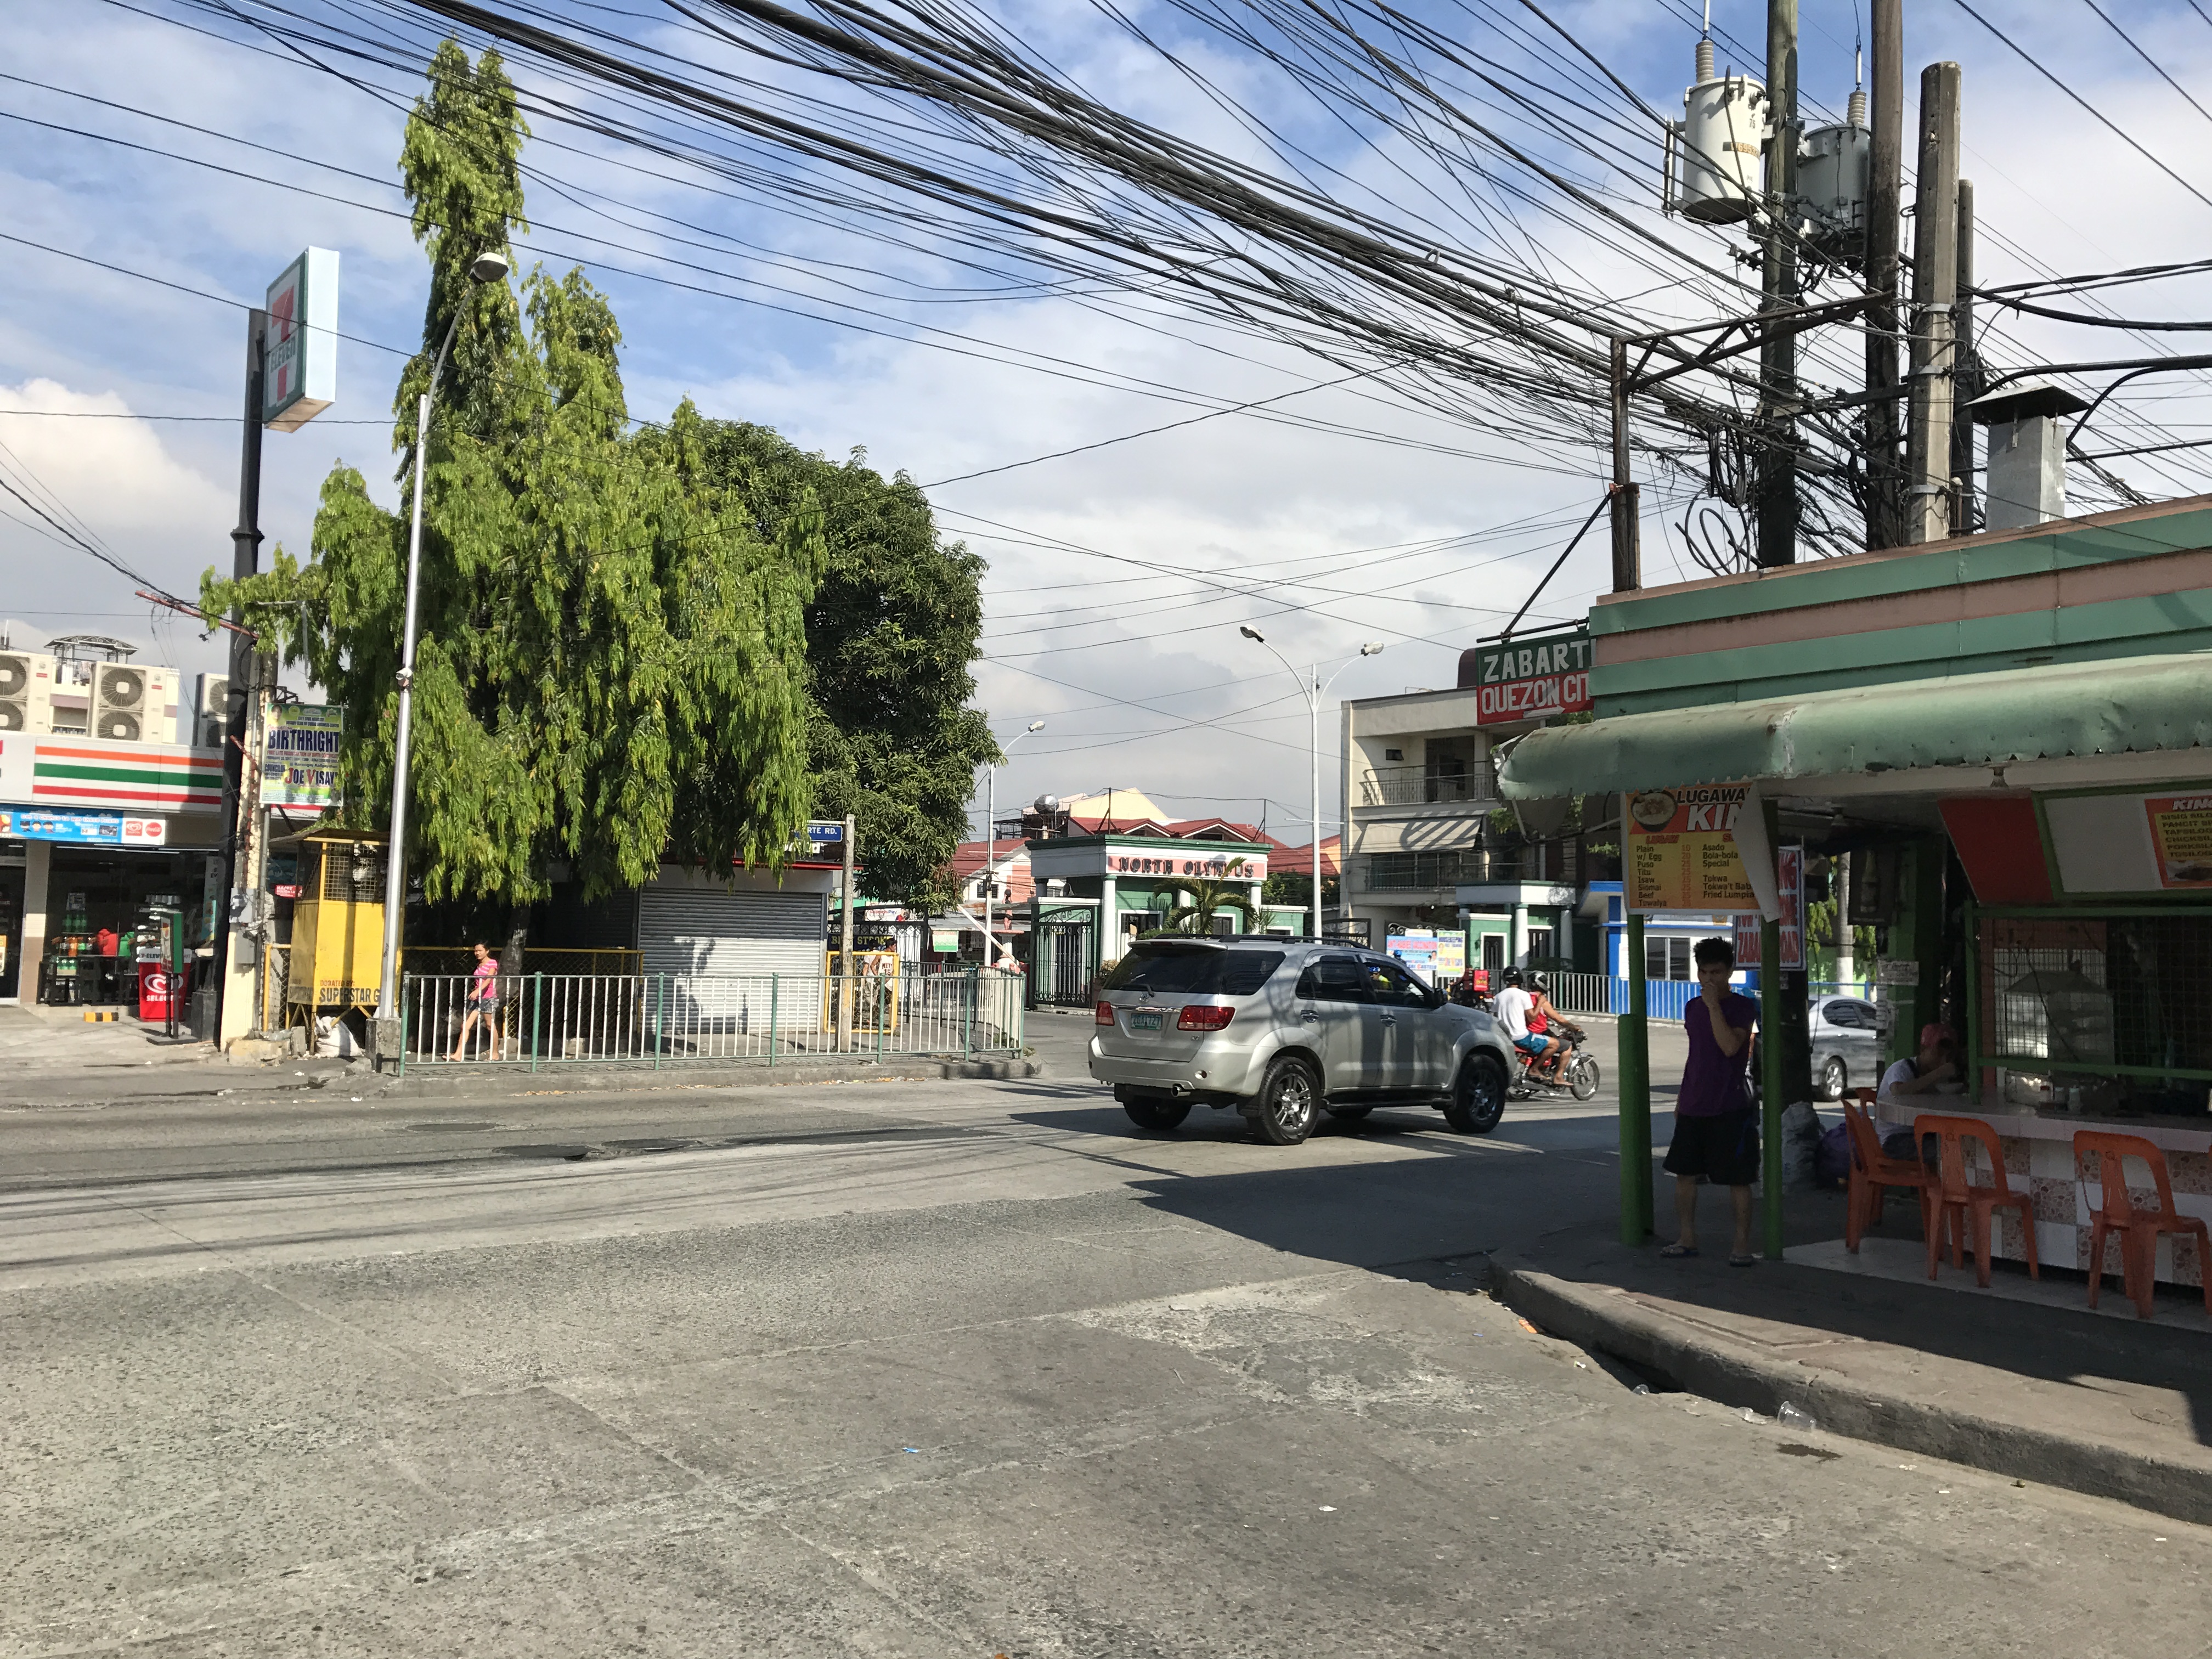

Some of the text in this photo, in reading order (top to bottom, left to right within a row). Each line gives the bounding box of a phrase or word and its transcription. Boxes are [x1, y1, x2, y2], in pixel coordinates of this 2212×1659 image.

[1481, 673, 1590, 714] QUEZON CIT
[268, 729, 339, 752] BIRTHRIGHT
[285, 767, 304, 785] JOE
[306, 769, 338, 785] VISAY
[1677, 787, 1751, 803] LUGAWA
[1118, 857, 1255, 879] NORTH OLYMUS
[1702, 860, 1730, 868] Special
[1724, 891, 1754, 899] Lumpia
[319, 988, 371, 1003] SUPERSTAR
